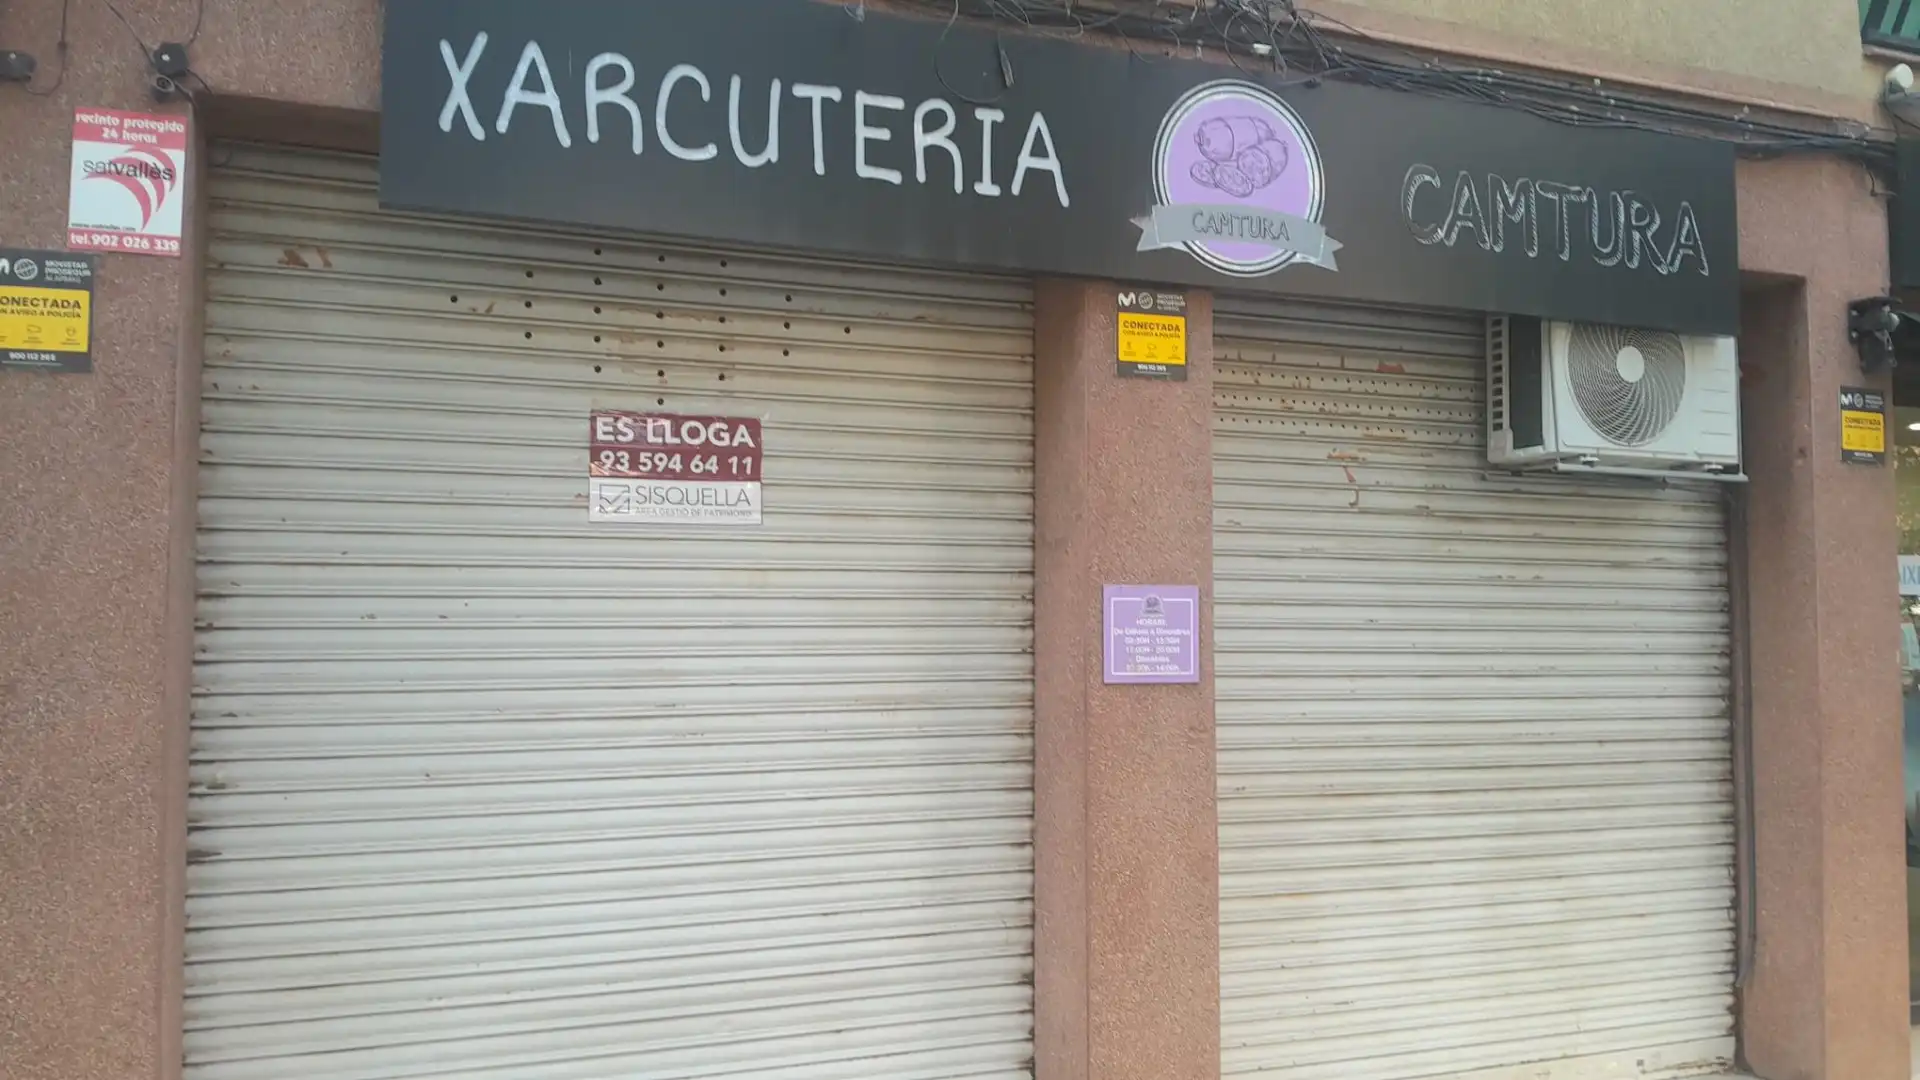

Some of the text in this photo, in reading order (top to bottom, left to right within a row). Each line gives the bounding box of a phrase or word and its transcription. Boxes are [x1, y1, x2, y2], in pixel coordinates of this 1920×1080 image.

[75, 112, 184, 132] recinto protegido
[438, 31, 1069, 207] XARCUTERIA
[102, 128, 157, 144] 24 horas
[1192, 212, 1290, 241] CAMTURA
[1401, 163, 1709, 277] CAMTURA
[122, 236, 150, 249] 026
[154, 239, 179, 251] 339
[0, 296, 82, 309] ONECTADA
[1123, 320, 1180, 332] CONECTADA
[596, 417, 756, 448] ES LLOGA
[600, 450, 752, 475] 93 594 64 11
[635, 484, 751, 507] SISQUELLA
